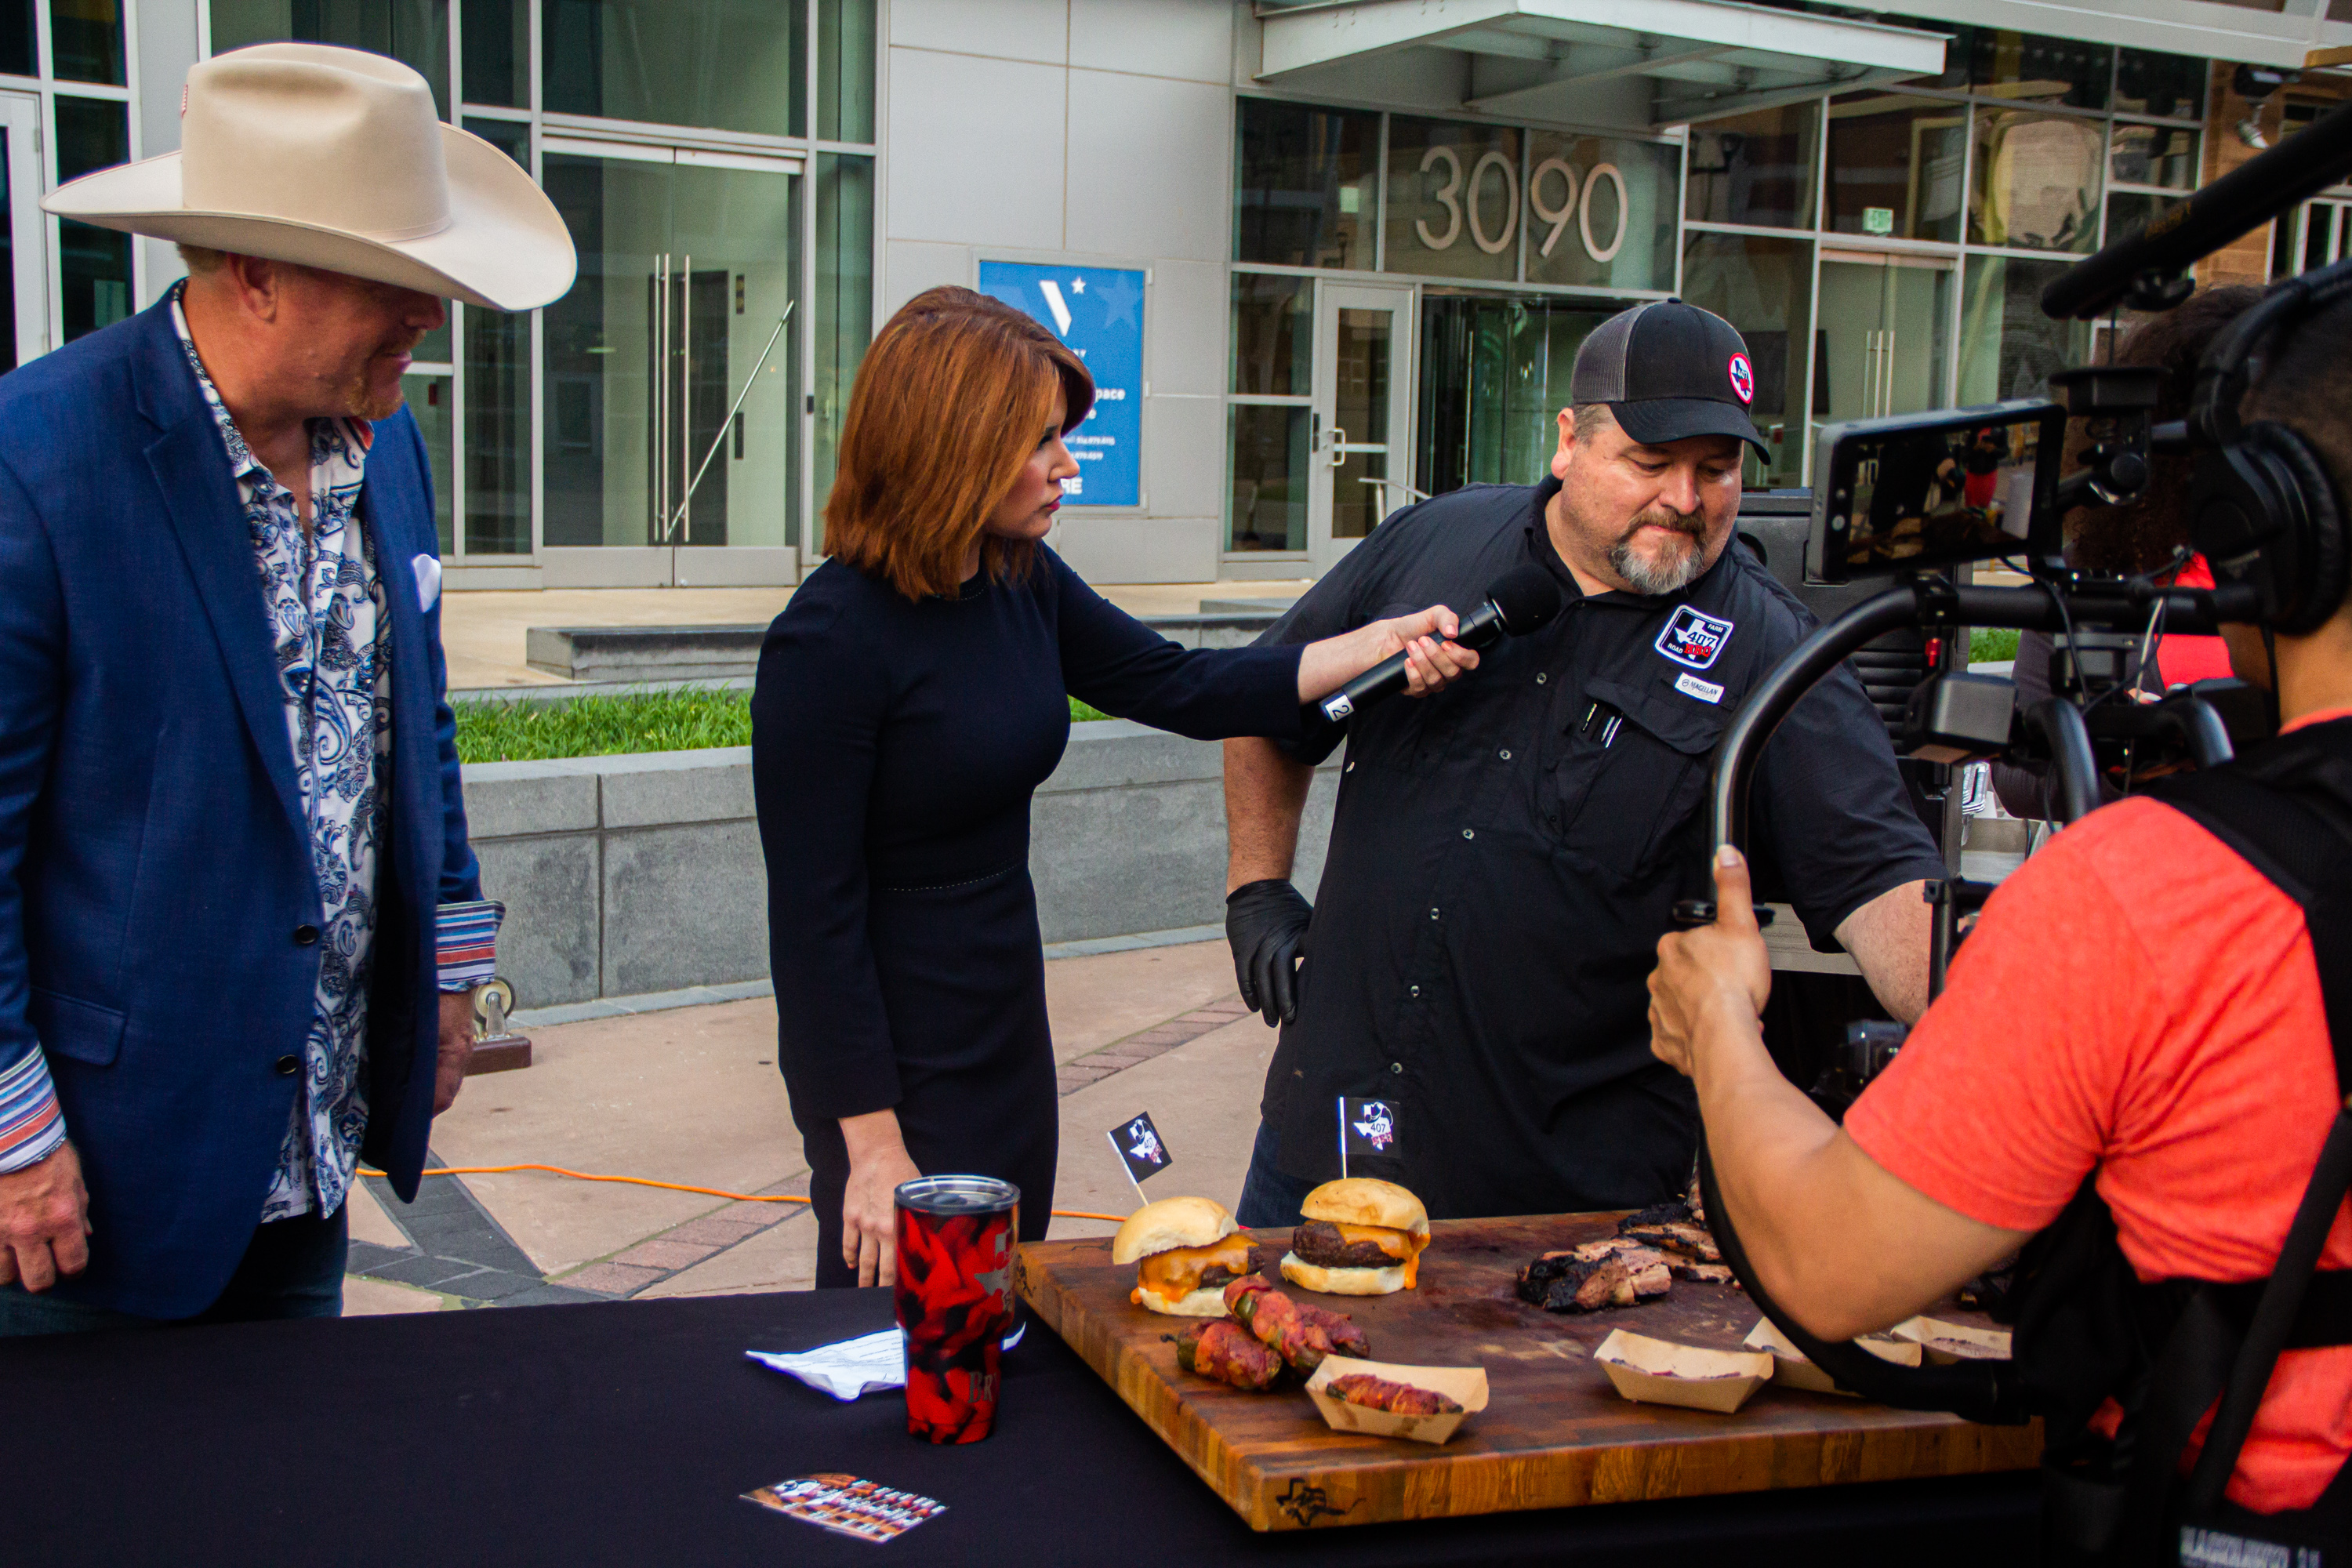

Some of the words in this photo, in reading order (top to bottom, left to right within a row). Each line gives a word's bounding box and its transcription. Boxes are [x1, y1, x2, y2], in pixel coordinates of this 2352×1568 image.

[1416, 145, 1628, 263] 3090
[1095, 387, 1126, 403] pace
[1708, 623, 1724, 633] FARM
[1686, 631, 1716, 648] 407
[1667, 642, 1684, 654] ROAD
[1683, 643, 1712, 658] BBQ
[1690, 681, 1719, 695] MAGELLAN
[1332, 704, 1350, 719] 2
[1370, 1123, 1386, 1133] 407
[1144, 1137, 1155, 1149] 407
